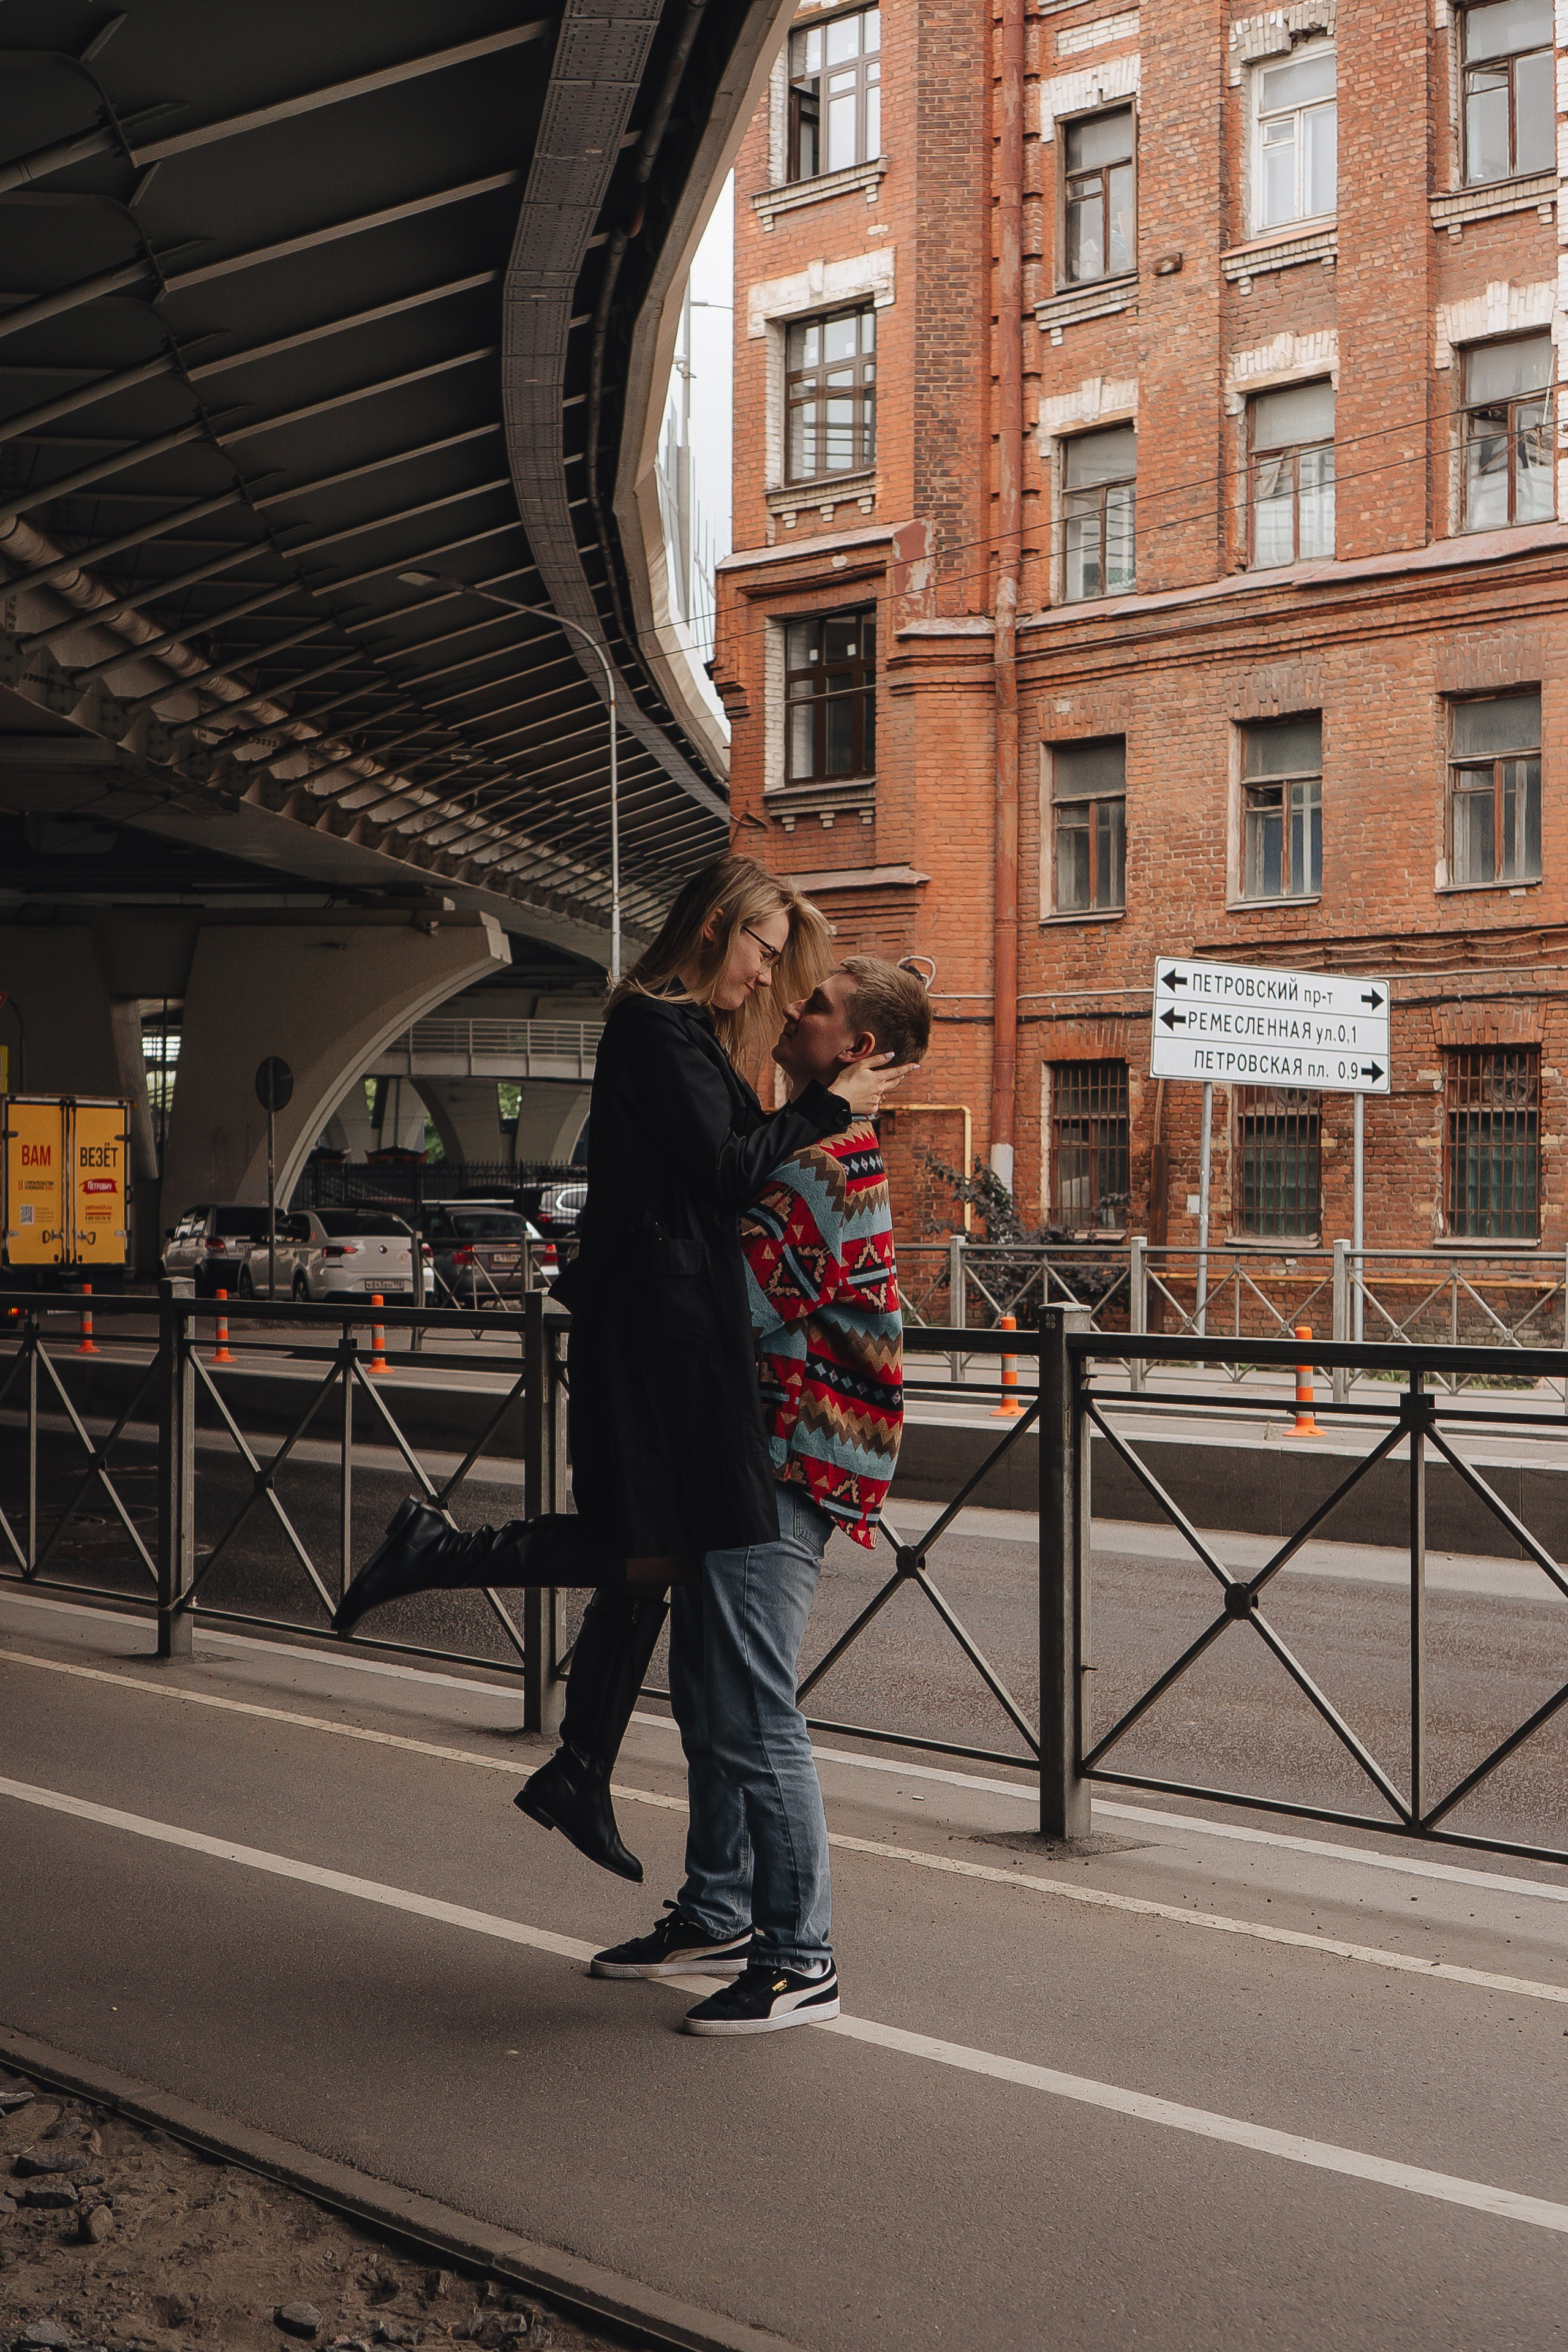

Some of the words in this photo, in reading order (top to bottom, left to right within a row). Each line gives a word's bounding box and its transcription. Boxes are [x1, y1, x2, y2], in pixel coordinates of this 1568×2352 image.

[1193, 973, 1298, 1001] ПЕТРОВСКИЙ
[1305, 990, 1333, 1008] пр-т
[1189, 1011, 1311, 1039] РЕМЕСЛЕННАЯ
[1194, 1050, 1302, 1076] ПЕТРОВСКАЯ
[1308, 1064, 1329, 1078] пл.
[1338, 1061, 1358, 1080] 0,9
[21, 1145, 51, 1166] ВАМ
[80, 1142, 118, 1167] ВЕЗЁТ
